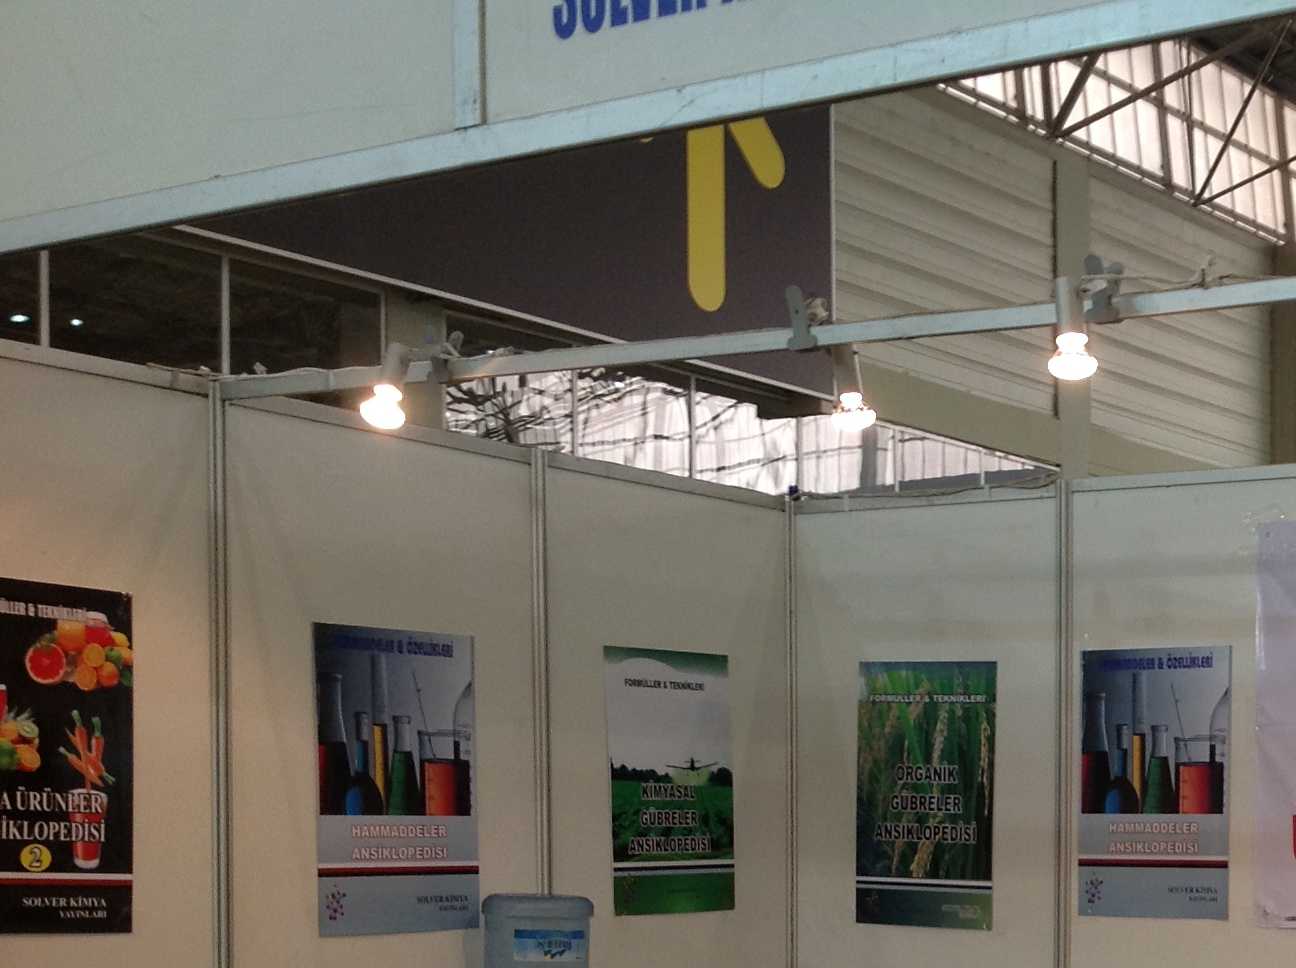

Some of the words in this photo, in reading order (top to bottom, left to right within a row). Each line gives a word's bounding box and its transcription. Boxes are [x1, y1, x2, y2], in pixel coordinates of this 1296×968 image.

[896, 762, 958, 783] ORGANİK
[17, 786, 102, 813] ÜRÜNLER
[642, 780, 696, 800] KİMYASAL
[890, 790, 962, 813] GÜBRELER
[641, 807, 698, 827] GÜBRELER
[352, 824, 446, 838] HAMMADDELER
[1108, 822, 1198, 834] HAMMADDELER
[30, 848, 42, 868] 2
[23, 897, 67, 908] SOLVER
[69, 895, 107, 908] KİMYA
